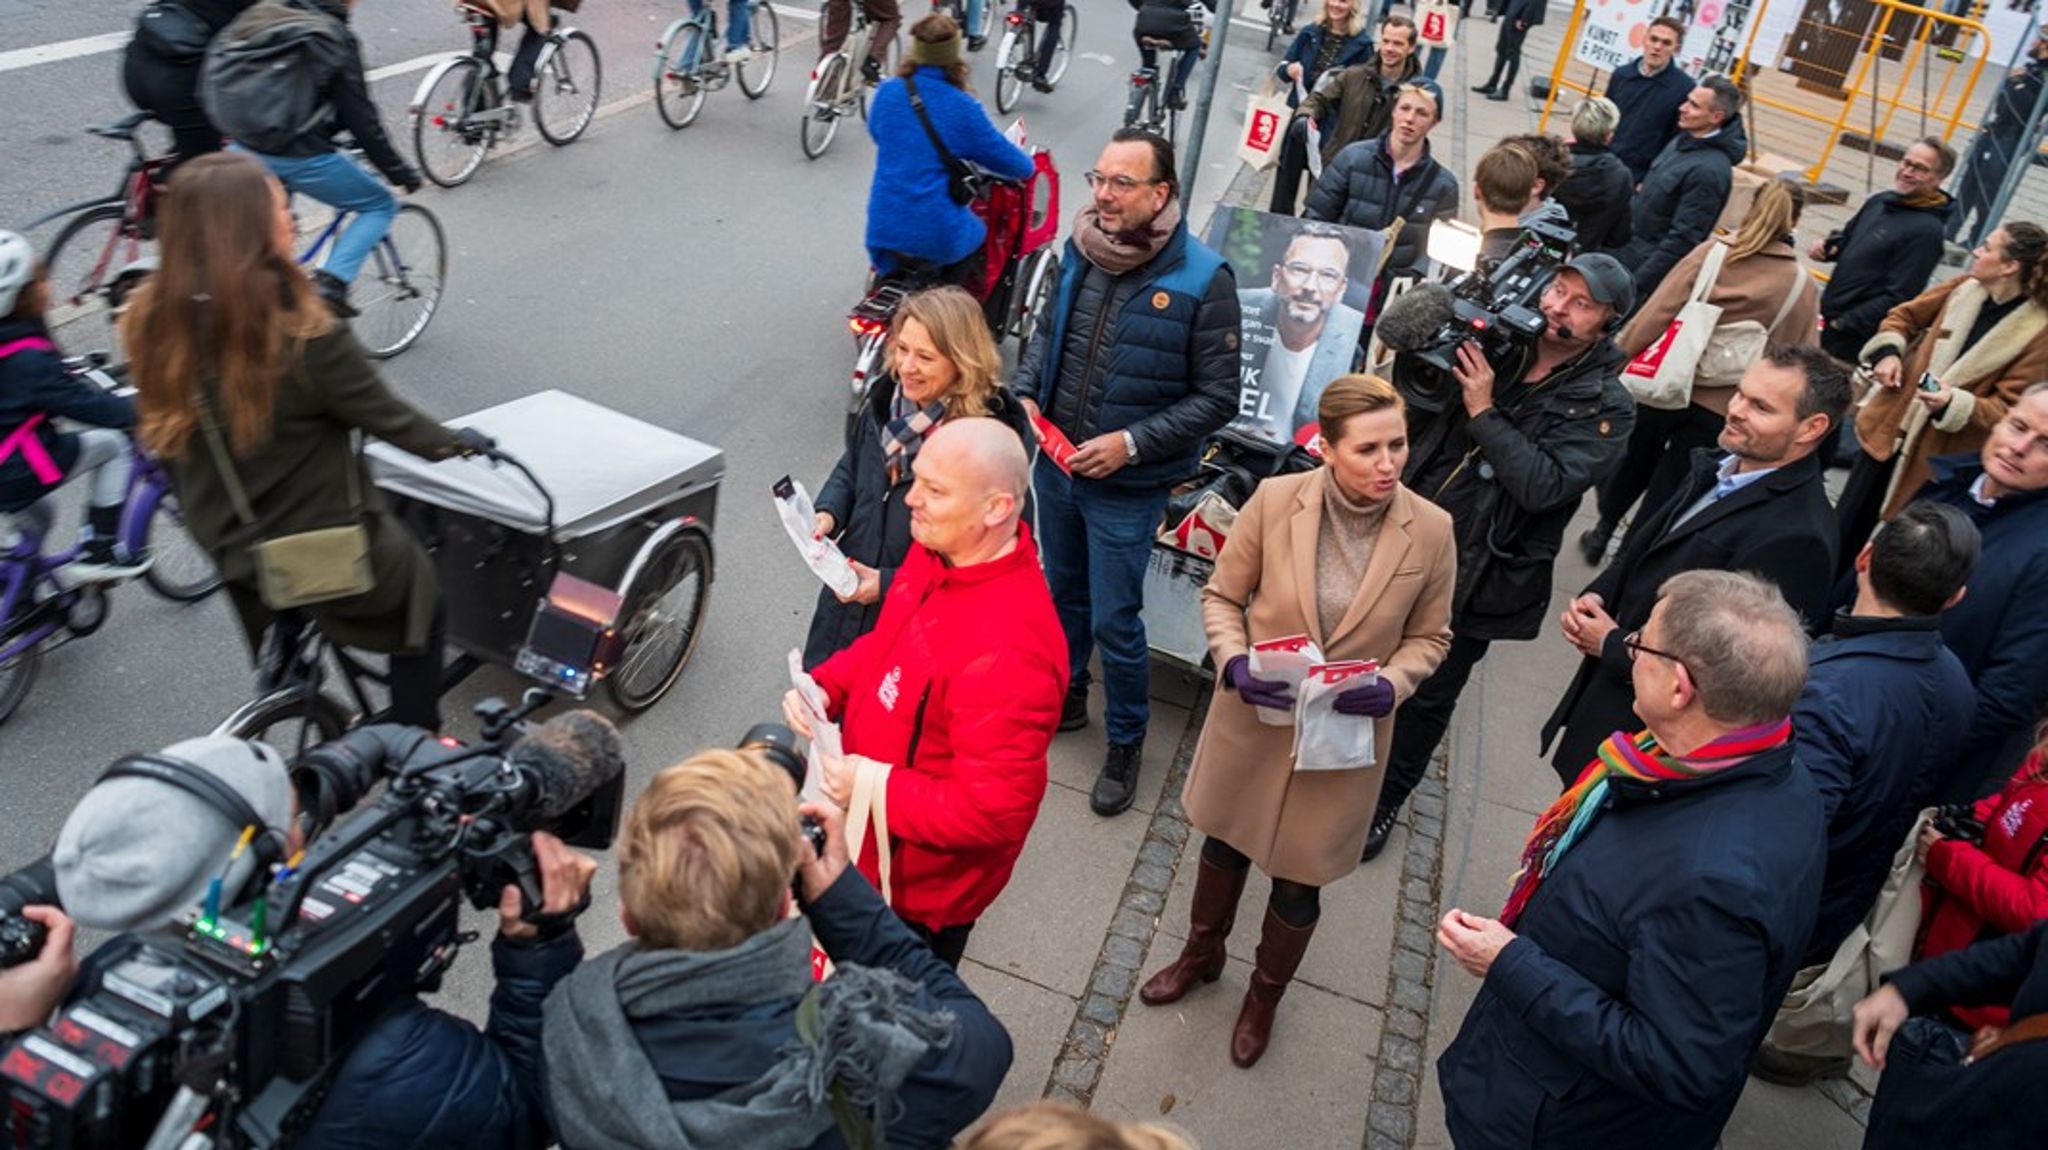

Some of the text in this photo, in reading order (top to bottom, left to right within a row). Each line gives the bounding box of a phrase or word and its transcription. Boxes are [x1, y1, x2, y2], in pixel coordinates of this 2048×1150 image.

[1587, 24, 1619, 46] KUNST
[1590, 43, 1623, 65] PSYKE
[1239, 387, 1275, 421] EL
